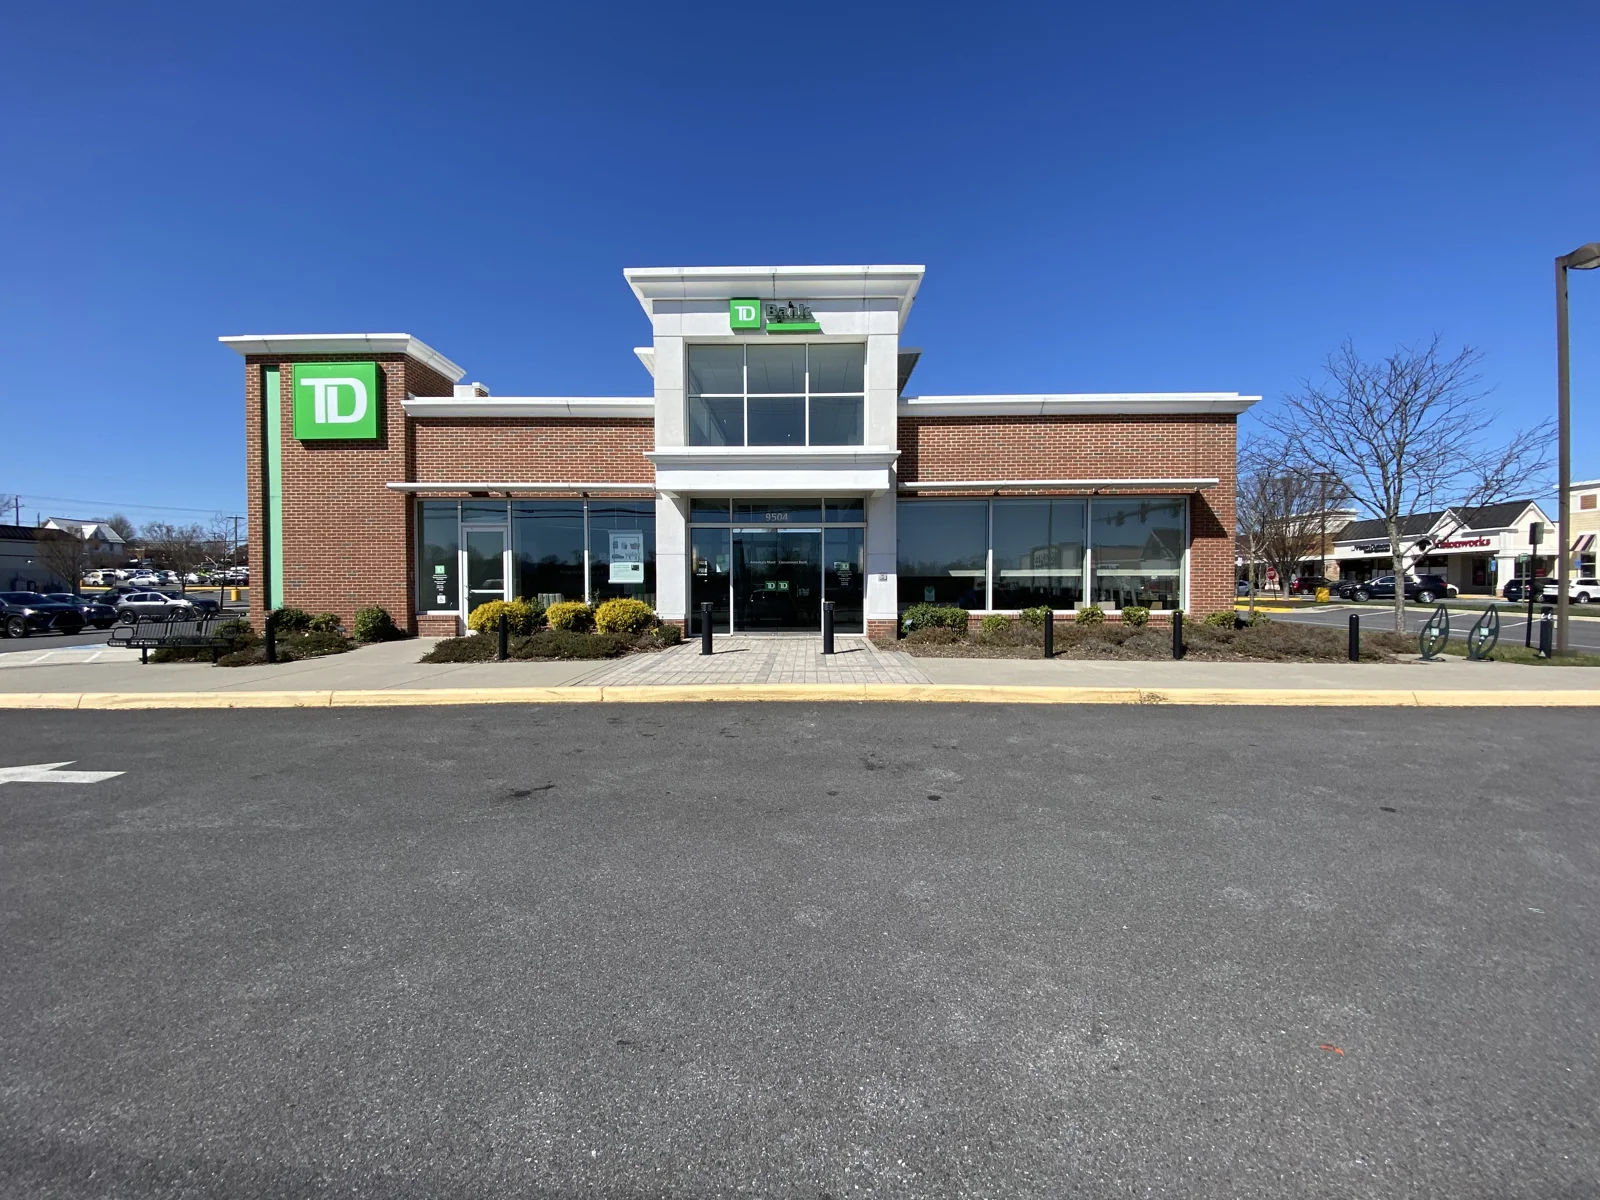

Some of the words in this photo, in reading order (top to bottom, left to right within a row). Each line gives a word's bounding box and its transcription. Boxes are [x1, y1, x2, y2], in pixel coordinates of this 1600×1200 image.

[735, 306, 756, 321] TD
[765, 303, 811, 319] Bank
[300, 377, 368, 424] TD
[765, 513, 788, 522] 9504
